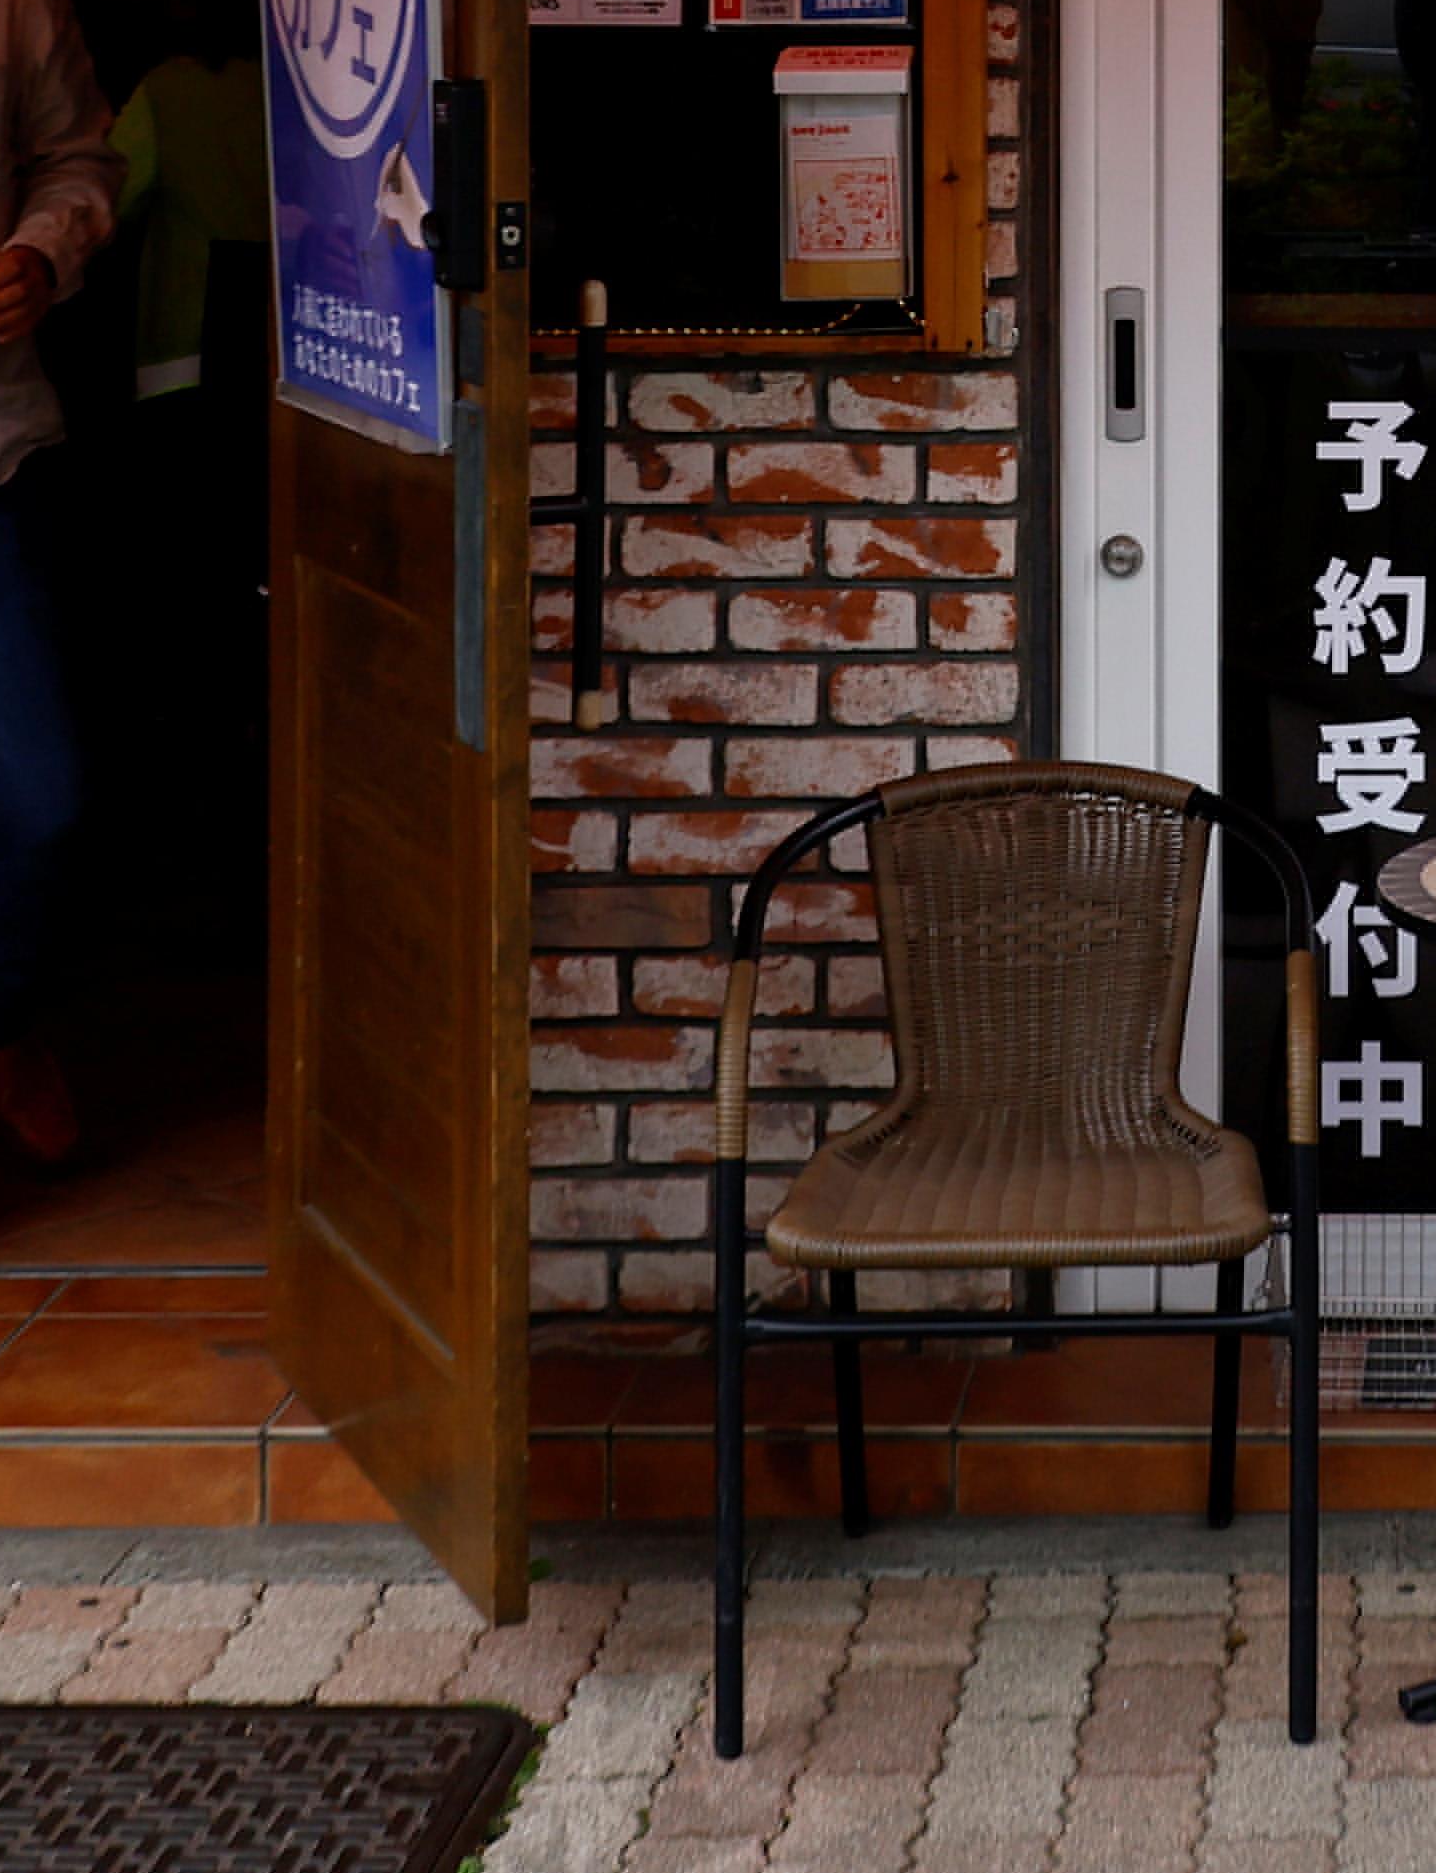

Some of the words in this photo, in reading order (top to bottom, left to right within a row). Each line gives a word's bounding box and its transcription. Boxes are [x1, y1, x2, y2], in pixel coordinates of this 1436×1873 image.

[1313, 399, 1428, 1158] 予約受付中
